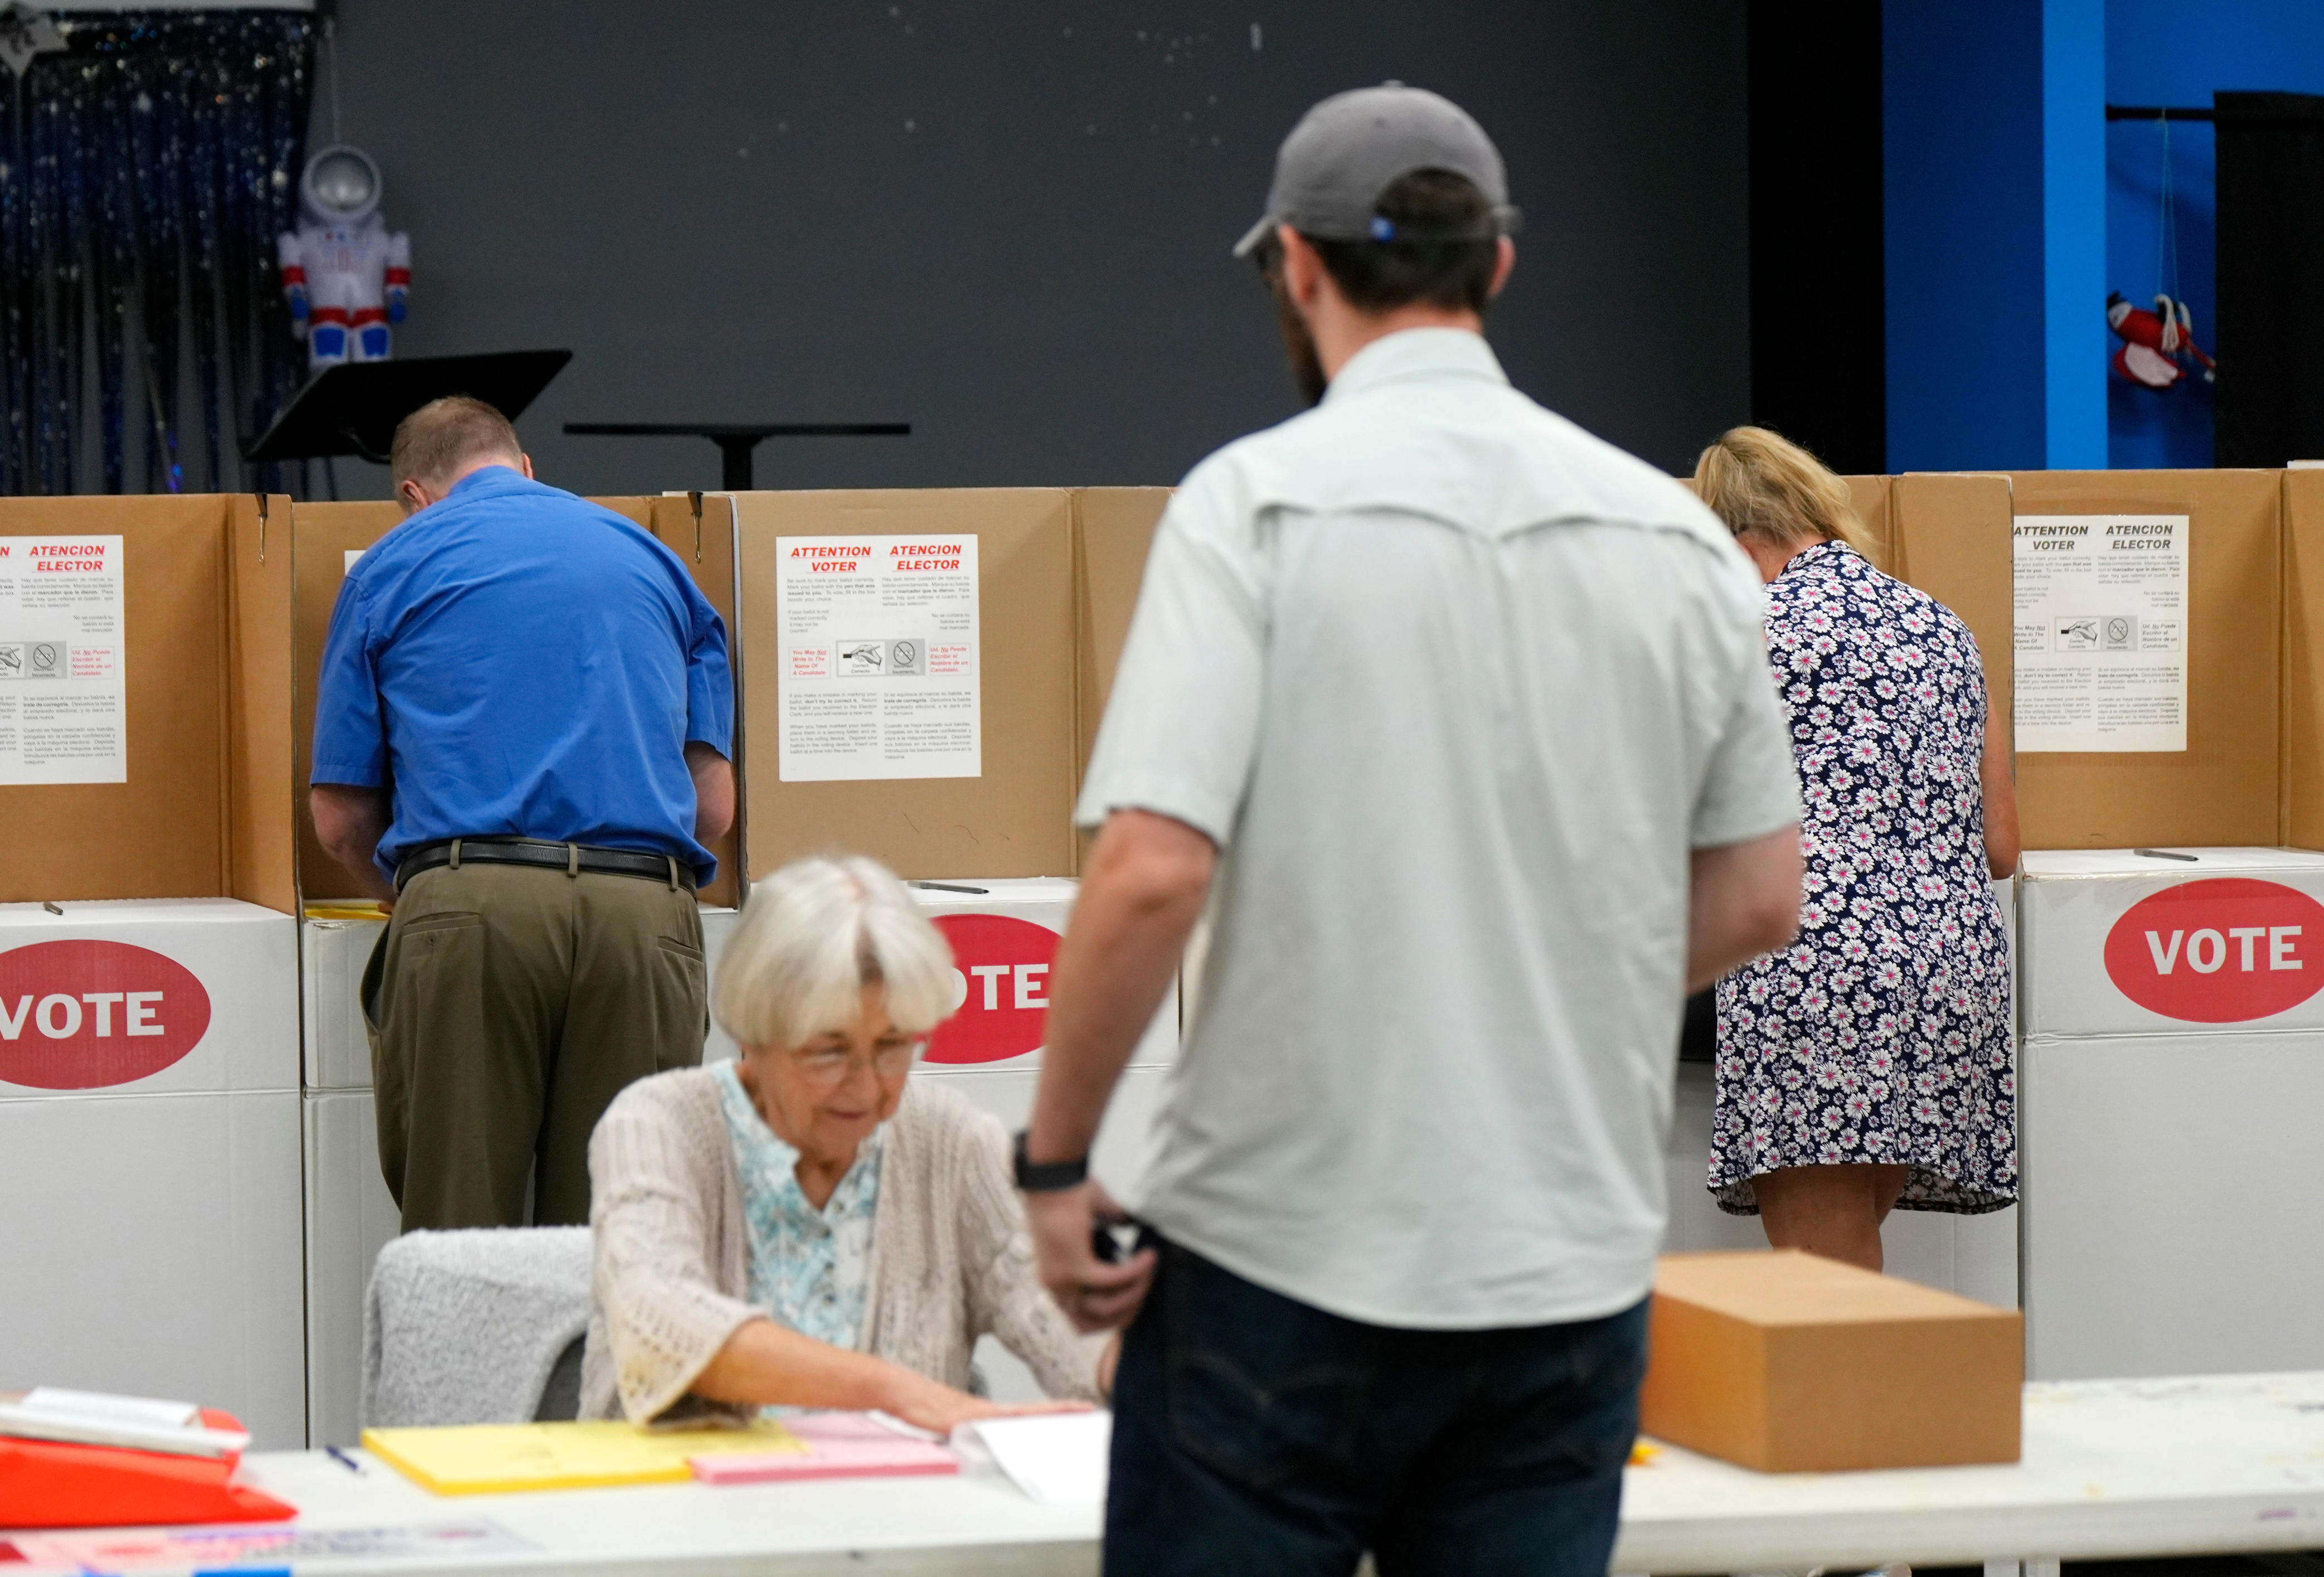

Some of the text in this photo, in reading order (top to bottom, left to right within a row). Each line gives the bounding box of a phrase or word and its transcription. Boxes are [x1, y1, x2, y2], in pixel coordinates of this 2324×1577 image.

[2014, 526, 2089, 535] ATTENTION
[2105, 525, 2173, 535] ATENCION
[2033, 541, 2075, 550] VOTER
[2112, 540, 2171, 549] ELECTOR
[29, 545, 105, 556] ATENCION
[791, 546, 871, 557] ATTENTION
[890, 545, 962, 556] ATENCION
[37, 560, 103, 571] ELECTOR
[812, 562, 856, 571] VOTER
[897, 560, 959, 570] ELECTOR
[2145, 925, 2303, 975] VOTE
[0, 991, 164, 1040] VOTE
